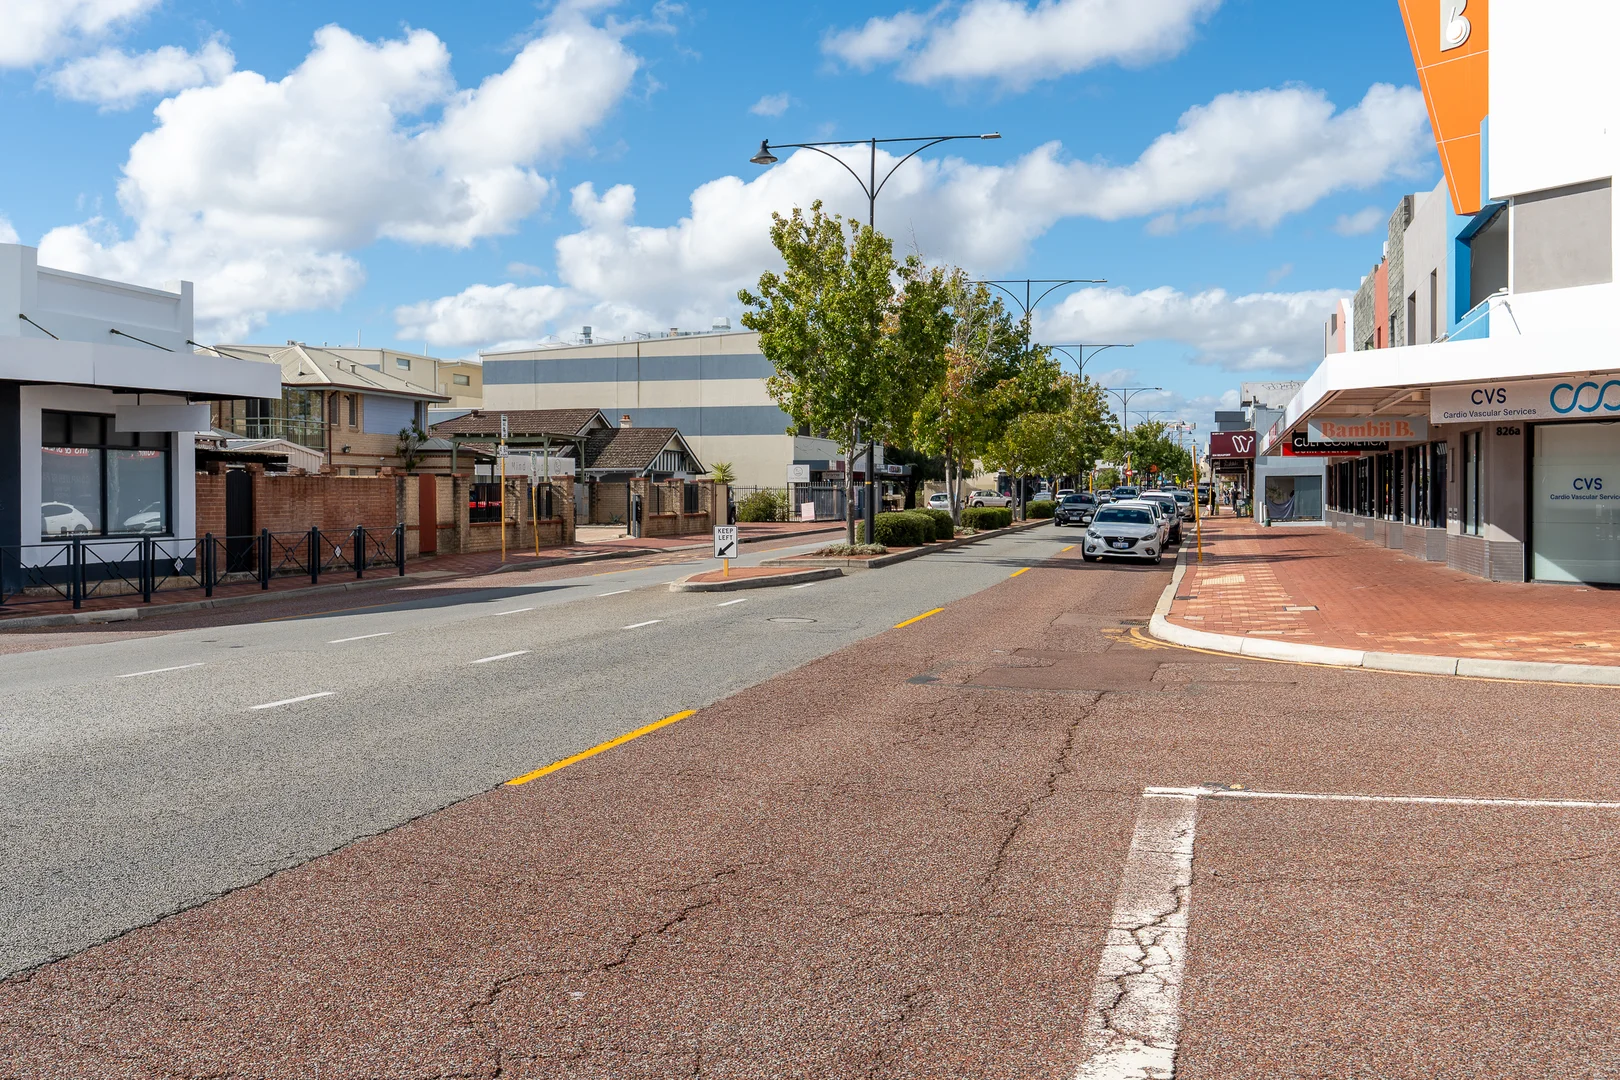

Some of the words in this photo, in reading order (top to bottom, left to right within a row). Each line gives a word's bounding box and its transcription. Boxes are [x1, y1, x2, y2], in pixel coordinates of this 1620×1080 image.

[1471, 388, 1507, 405] CVS
[1443, 411, 1467, 419] Cardio
[1469, 409, 1501, 418] Vascular
[1503, 407, 1537, 416] Services
[1320, 420, 1391, 438] Bambii
[1395, 421, 1415, 437] B.
[1496, 426, 1521, 436] 826a
[1573, 477, 1603, 491] CVS
